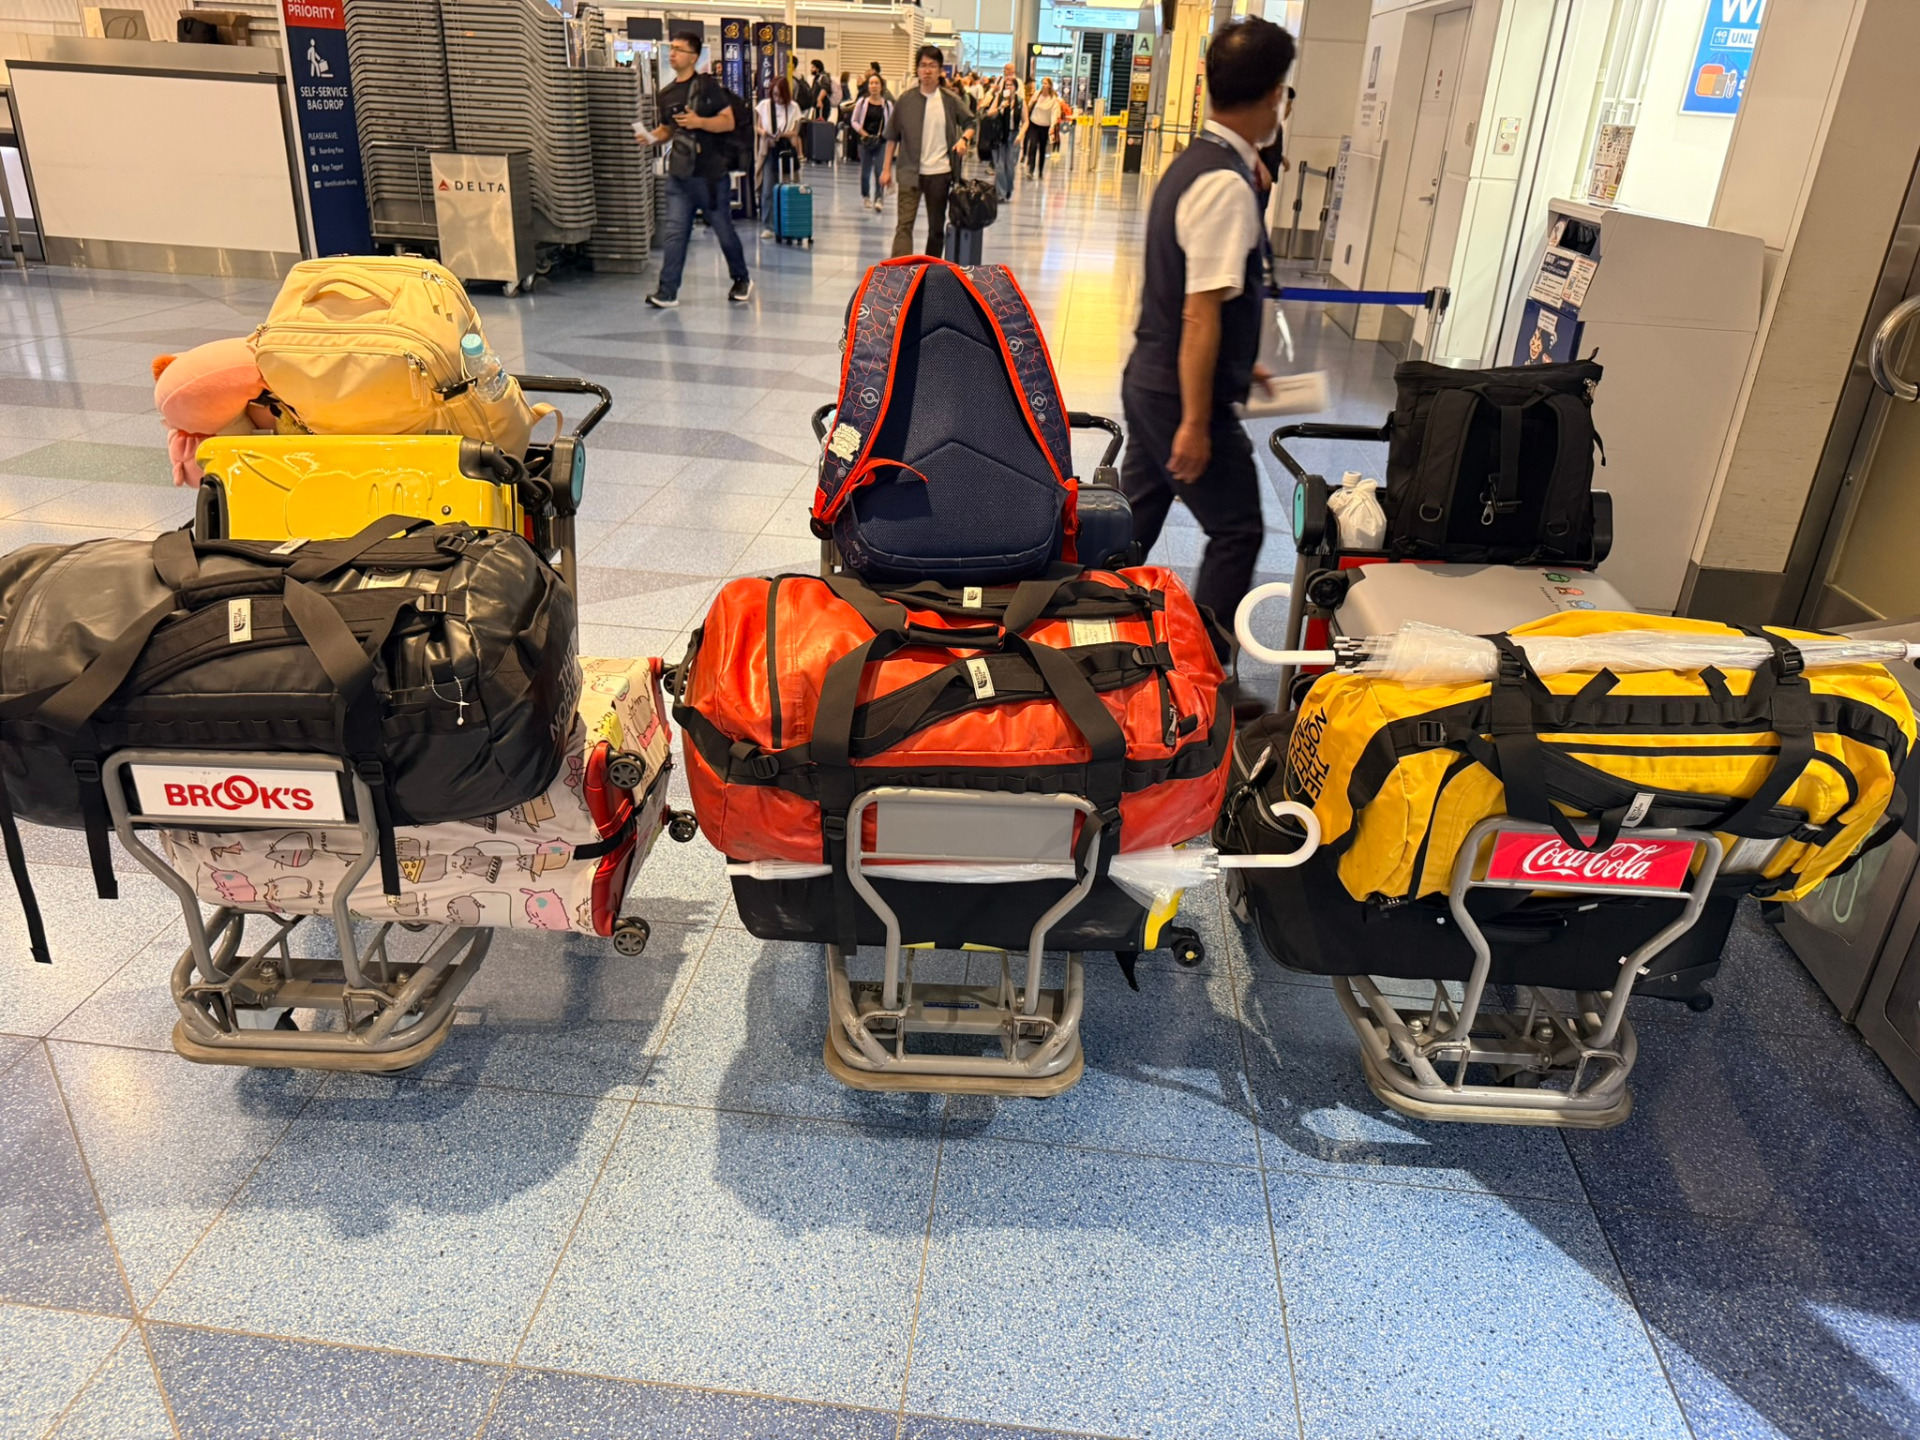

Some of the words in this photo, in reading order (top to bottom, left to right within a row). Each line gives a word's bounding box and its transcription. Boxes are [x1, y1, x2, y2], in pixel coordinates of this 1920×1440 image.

[288, 4, 335, 19] PRIORITY
[1715, 30, 1728, 38] 4G
[1138, 37, 1149, 51] A
[1066, 55, 1072, 64] B
[1081, 56, 1088, 65] B
[300, 86, 348, 97] SELF-SERVICE
[307, 99, 322, 110] BAG
[323, 99, 344, 110] DROP
[308, 132, 324, 140] PLEASE
[455, 180, 506, 193] DELTA
[1297, 707, 1328, 783] NORTH
[1304, 755, 1330, 800] THE
[164, 775, 314, 810] BROOK'S
